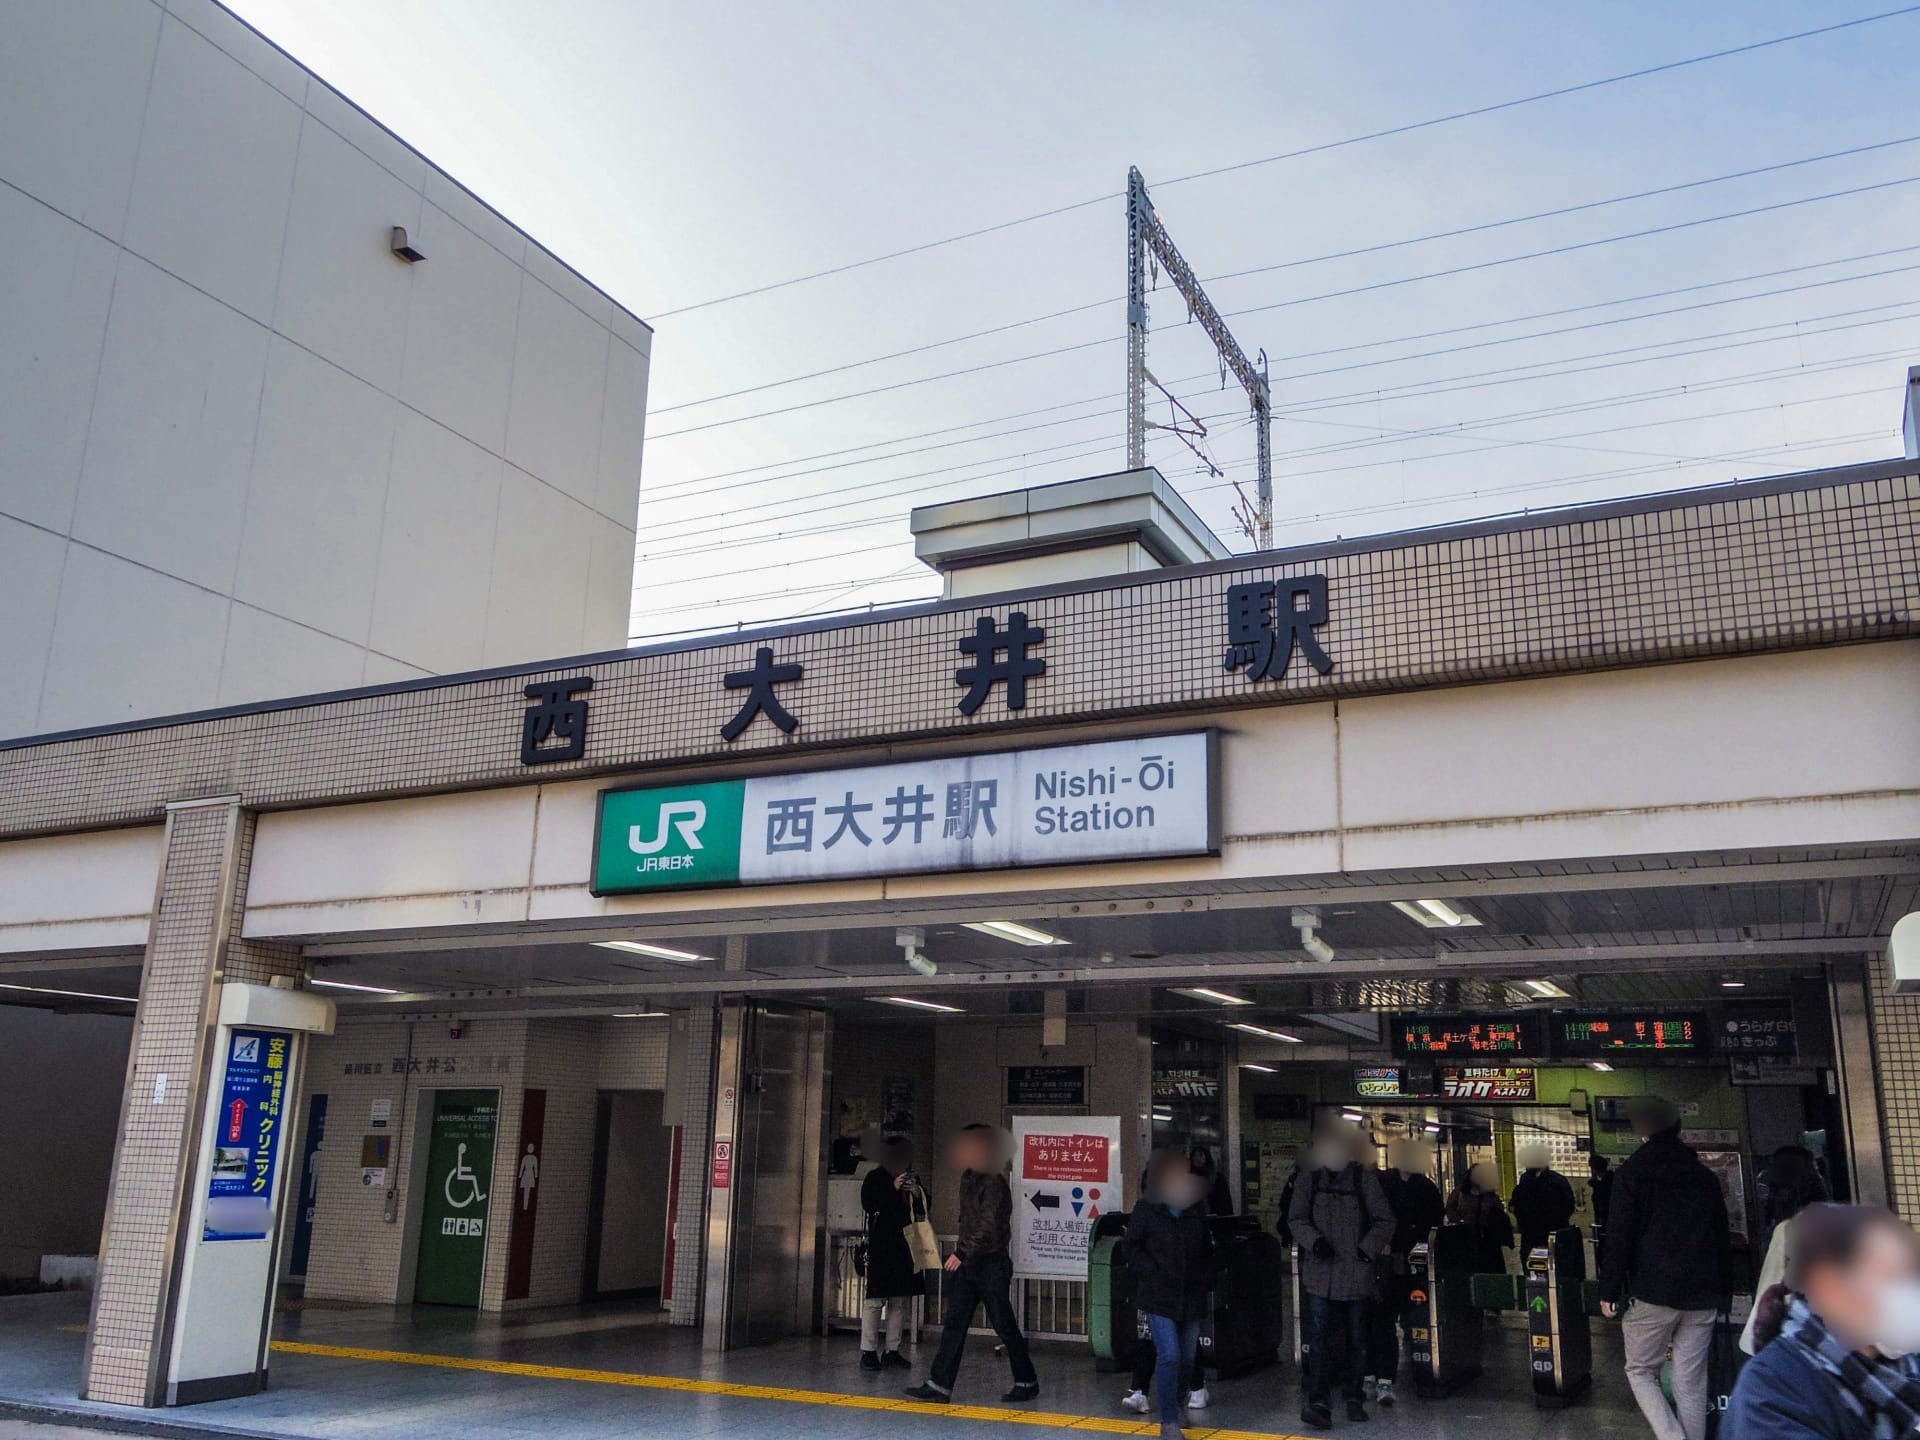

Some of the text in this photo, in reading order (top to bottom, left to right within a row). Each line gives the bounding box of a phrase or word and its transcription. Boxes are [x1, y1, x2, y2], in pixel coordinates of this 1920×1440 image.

[520, 574, 1335, 766] 西大井駅
[1034, 755, 1175, 801] Nishi-Ōi
[766, 778, 998, 855] 西大井駅
[1034, 802, 1156, 836] Station
[628, 799, 707, 855] JR
[636, 854, 695, 872] JR東日本
[1515, 1024, 1521, 1033] 1
[1683, 1021, 1691, 1031] 2
[1684, 1031, 1692, 1040] 2
[1516, 1041, 1522, 1050] 1
[1029, 1136, 1104, 1149] 改札内にトイレは
[251, 1118, 274, 1193] クリニック
[1038, 1149, 1094, 1162] ありません
